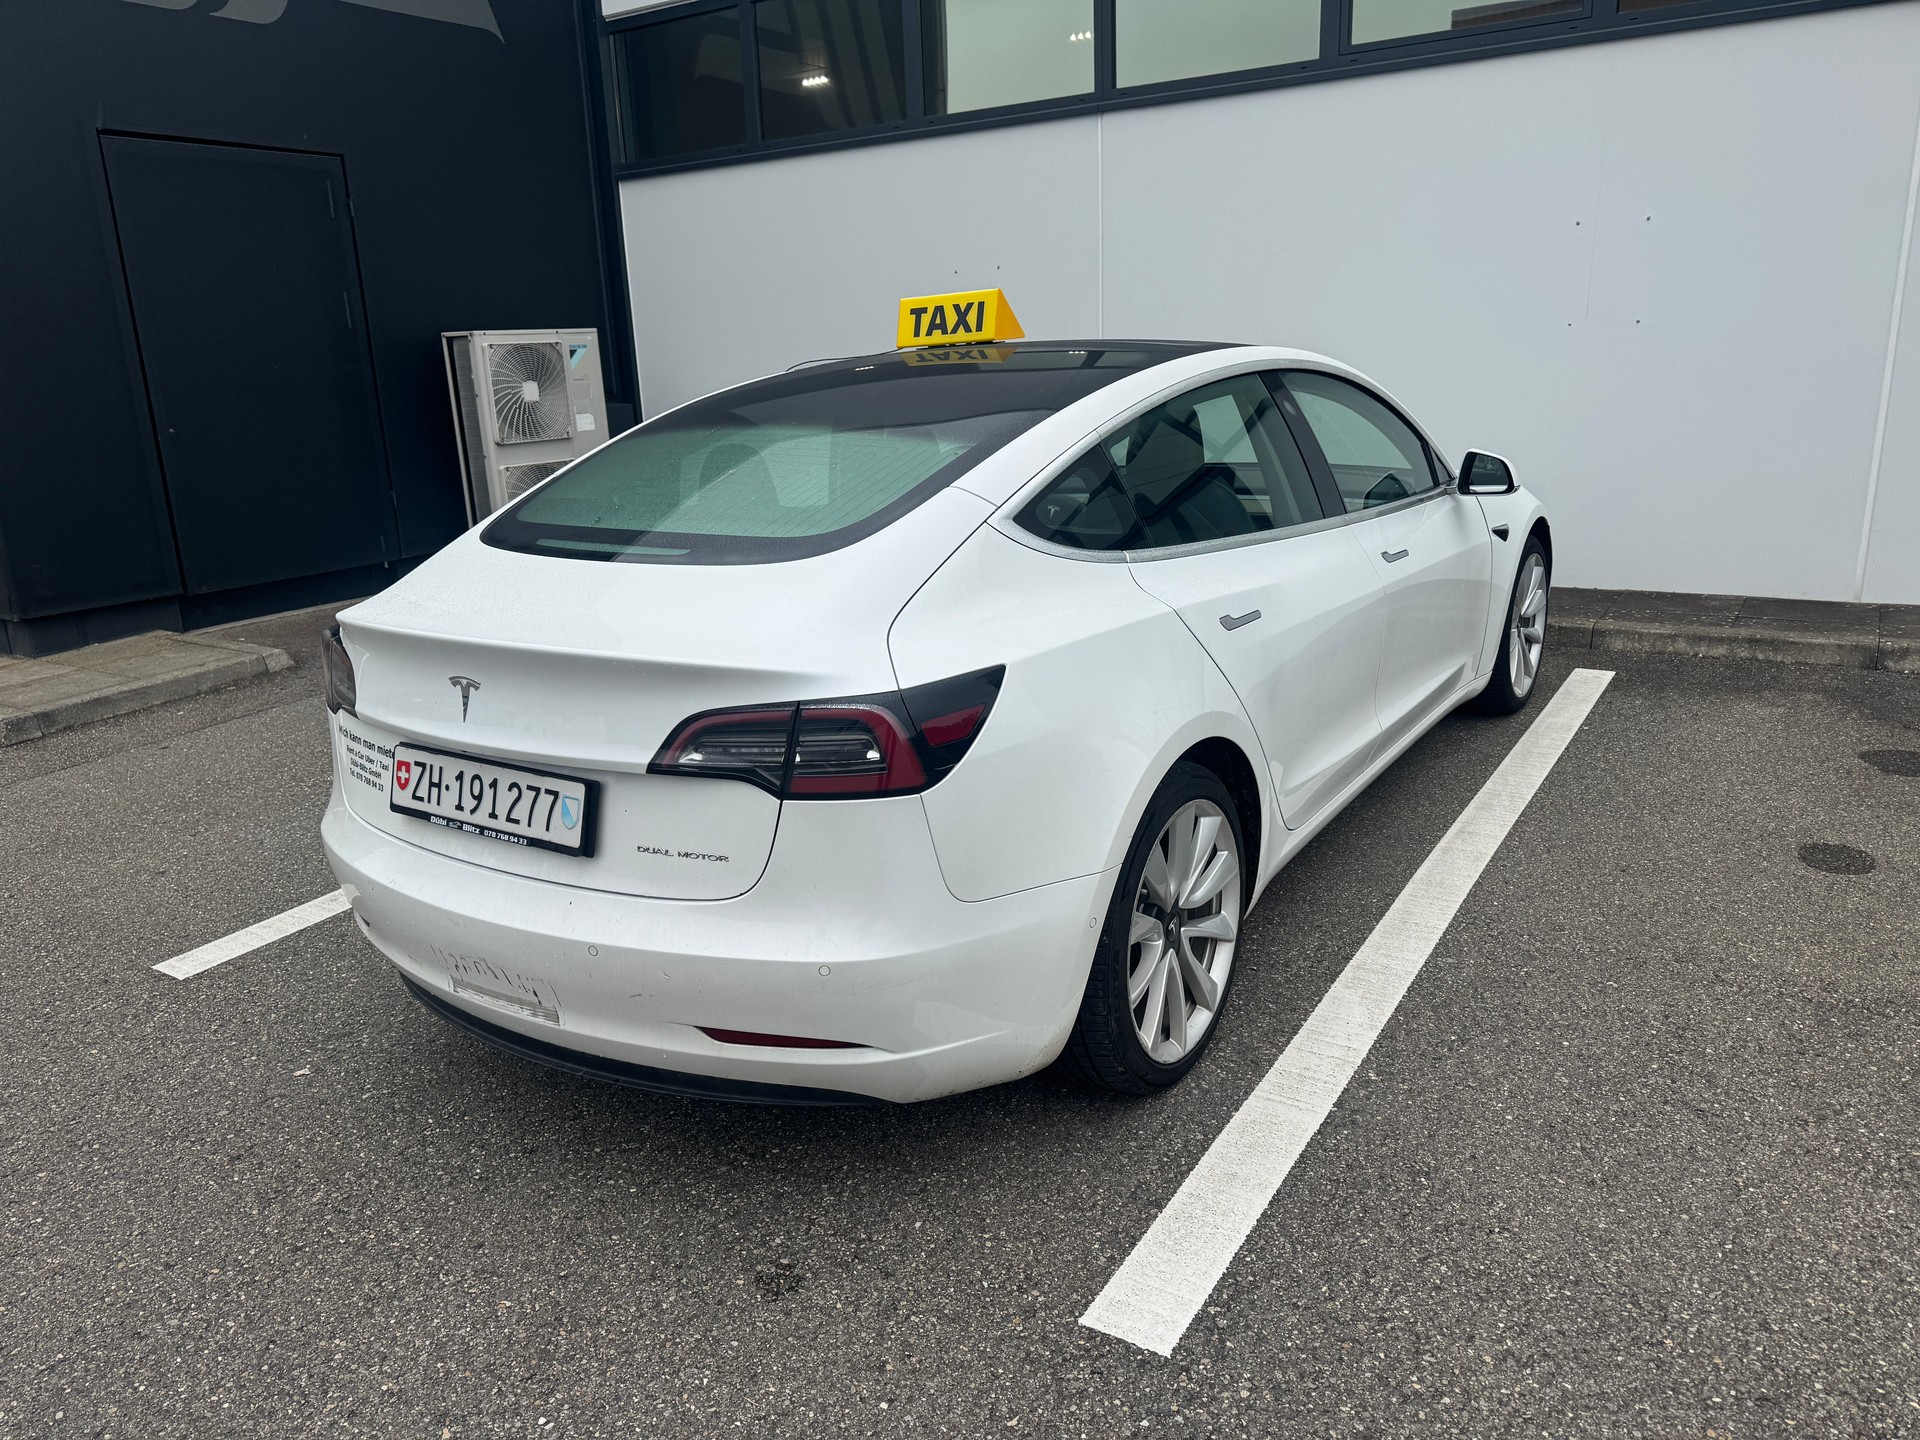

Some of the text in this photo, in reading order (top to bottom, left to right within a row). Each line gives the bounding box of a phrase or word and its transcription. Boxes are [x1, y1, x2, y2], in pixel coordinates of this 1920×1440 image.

[909, 301, 985, 338] TAXI
[338, 724, 349, 739] Mich
[349, 730, 361, 746] kann
[363, 739, 376, 752] man
[346, 744, 355, 756] Rent
[365, 754, 375, 766] Uber
[379, 760, 390, 772] Taxi
[363, 775, 372, 787] 768
[371, 779, 378, 789] 94
[377, 782, 384, 792] 33
[368, 767, 382, 780] GmbH
[430, 815, 527, 846] Dübi Blitz 078 768 94 33
[637, 845, 729, 863] DUAL MOTOR
